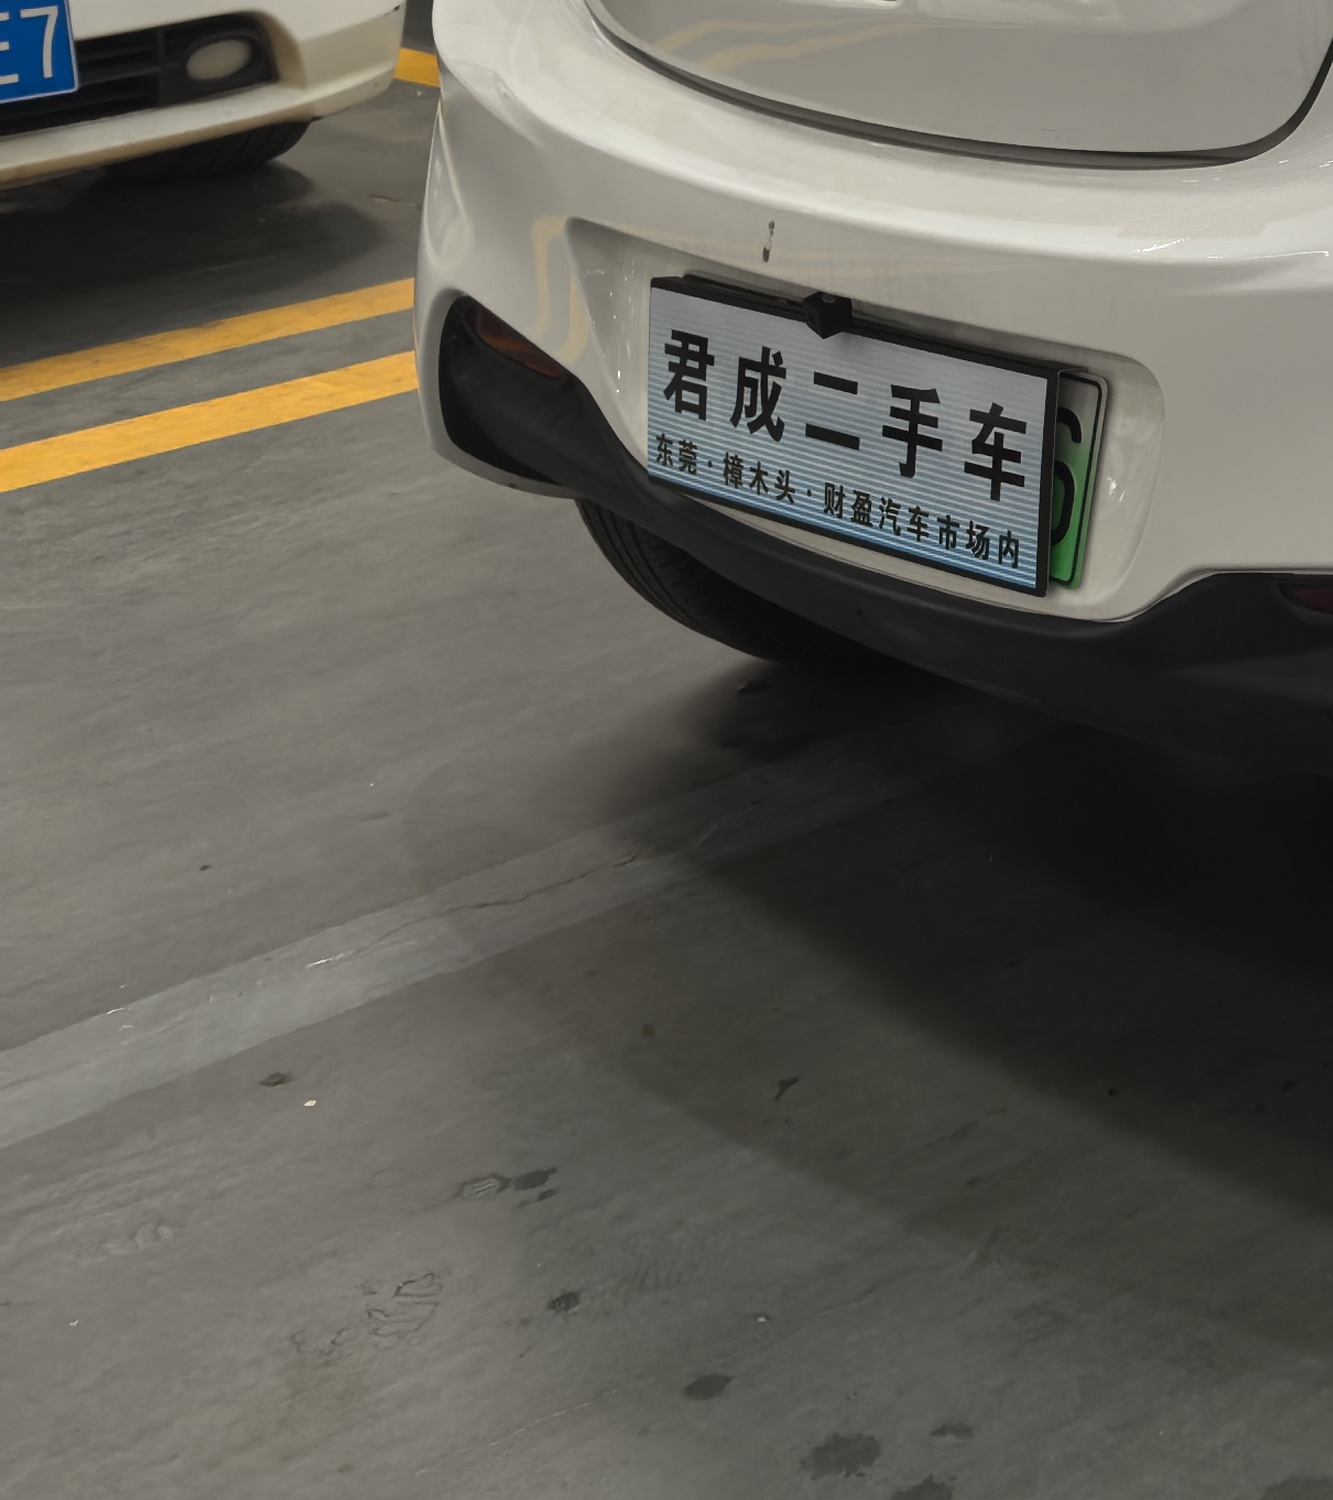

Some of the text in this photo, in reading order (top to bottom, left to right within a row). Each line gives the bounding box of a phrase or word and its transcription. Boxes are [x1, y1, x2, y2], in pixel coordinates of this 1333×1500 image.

[662, 328, 1027, 502] 君成二手车
